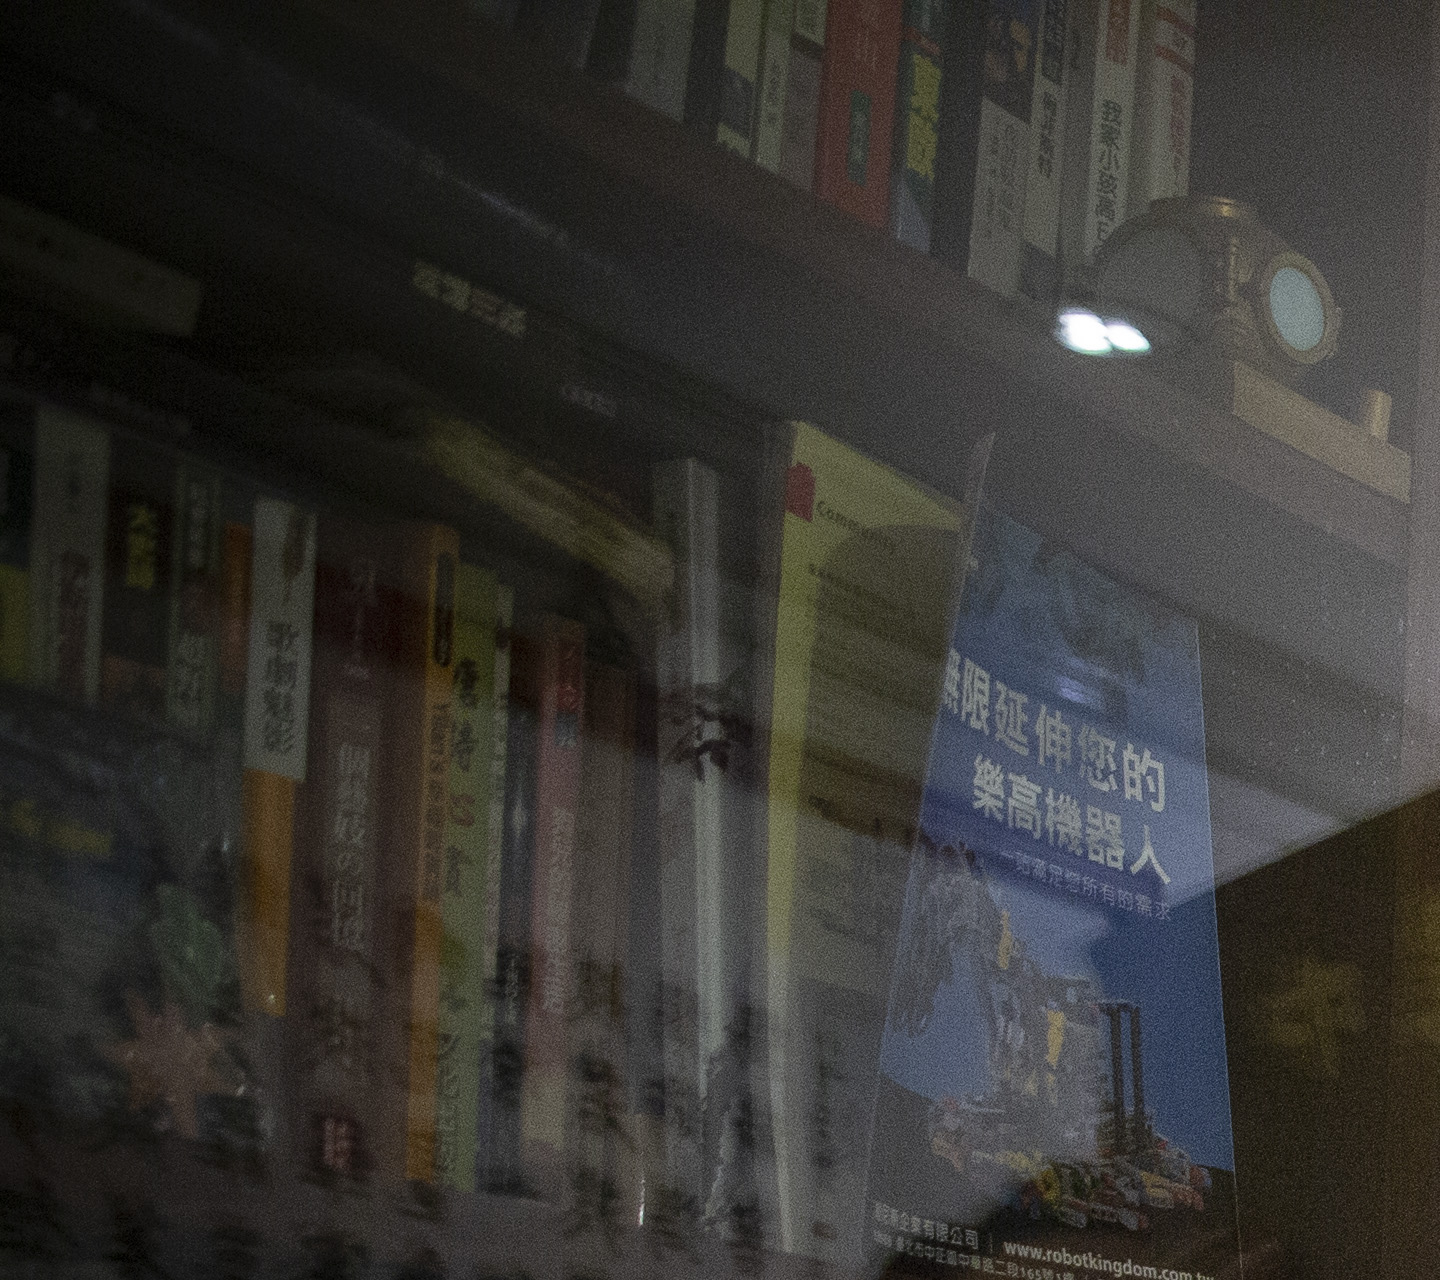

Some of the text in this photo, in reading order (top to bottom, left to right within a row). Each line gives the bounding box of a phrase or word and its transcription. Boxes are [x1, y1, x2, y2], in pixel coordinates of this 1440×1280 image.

[971, 754, 1172, 886] 樂高機器人
